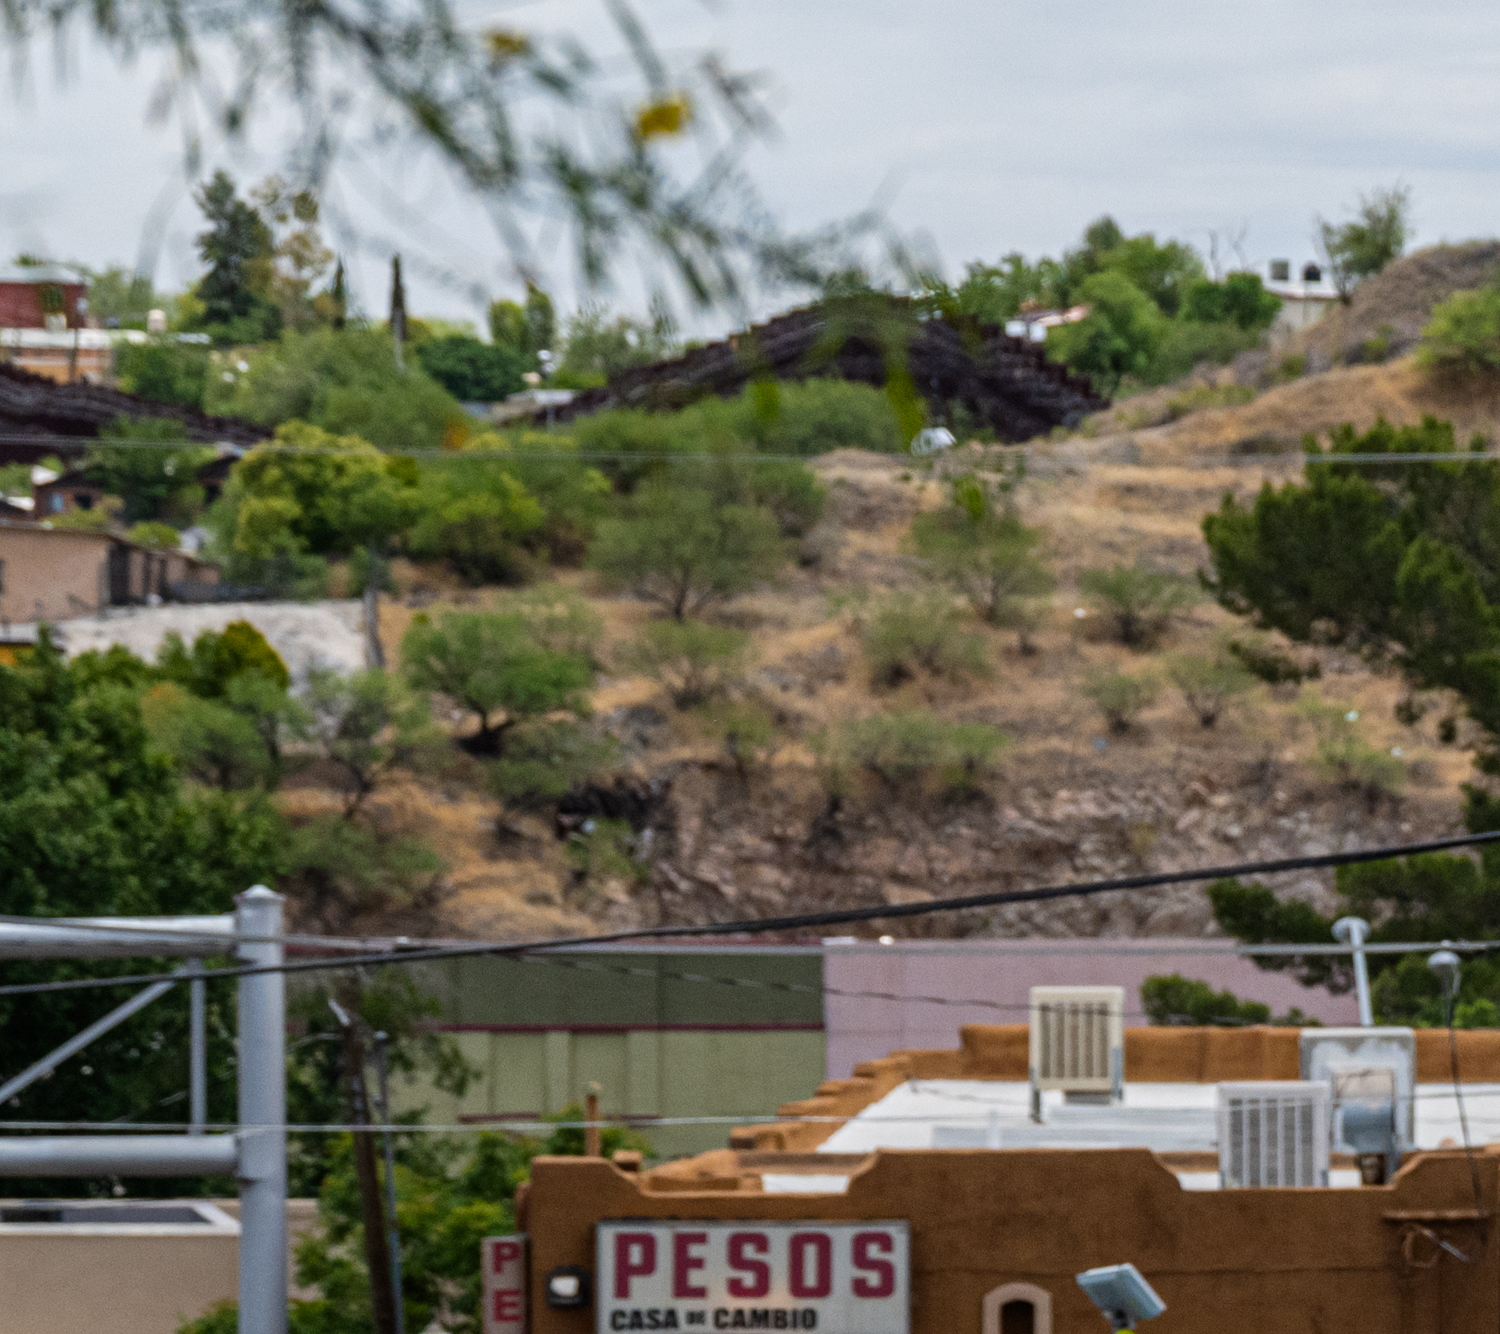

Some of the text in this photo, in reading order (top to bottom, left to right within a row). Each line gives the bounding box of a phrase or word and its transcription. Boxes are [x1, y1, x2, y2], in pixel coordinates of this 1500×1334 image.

[614, 1231, 896, 1300] PESOS
[610, 1308, 680, 1331] CASA
[713, 1307, 818, 1331] CAMBIO
